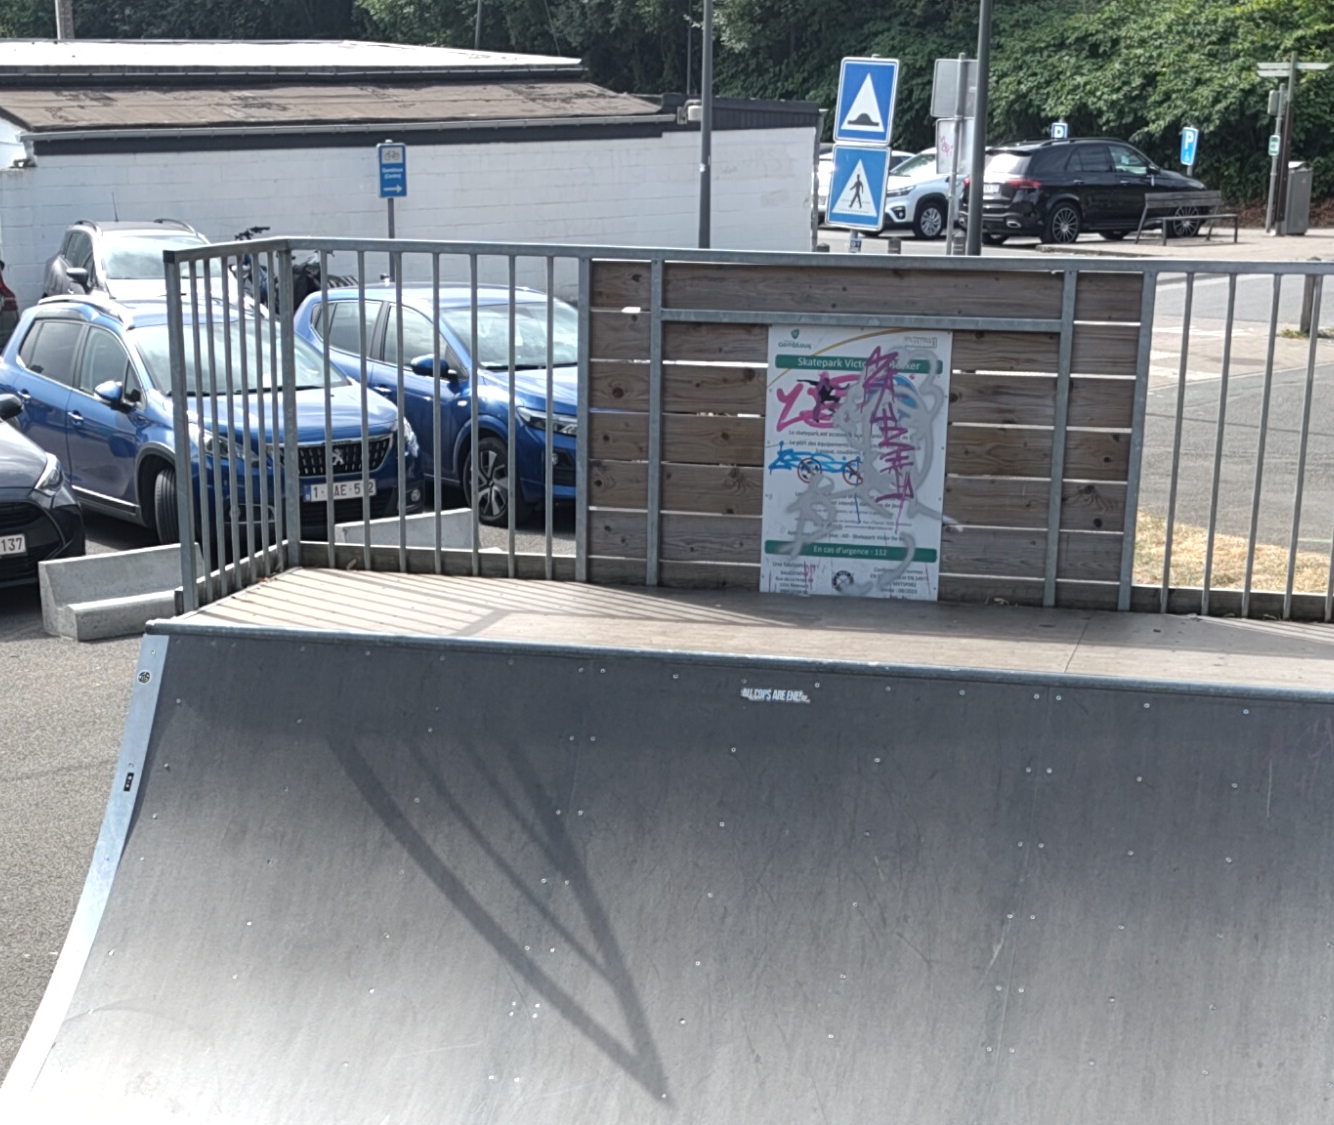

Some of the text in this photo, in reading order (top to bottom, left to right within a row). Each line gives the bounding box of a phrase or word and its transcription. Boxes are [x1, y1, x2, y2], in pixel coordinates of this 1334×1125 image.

[1185, 131, 1194, 149] P
[797, 357, 843, 368] Skatepark
[313, 482, 374, 498] 1-AE-52
[813, 545, 822, 553] En
[835, 546, 869, 556] d'urgence
[772, 688, 786, 701] ARE
